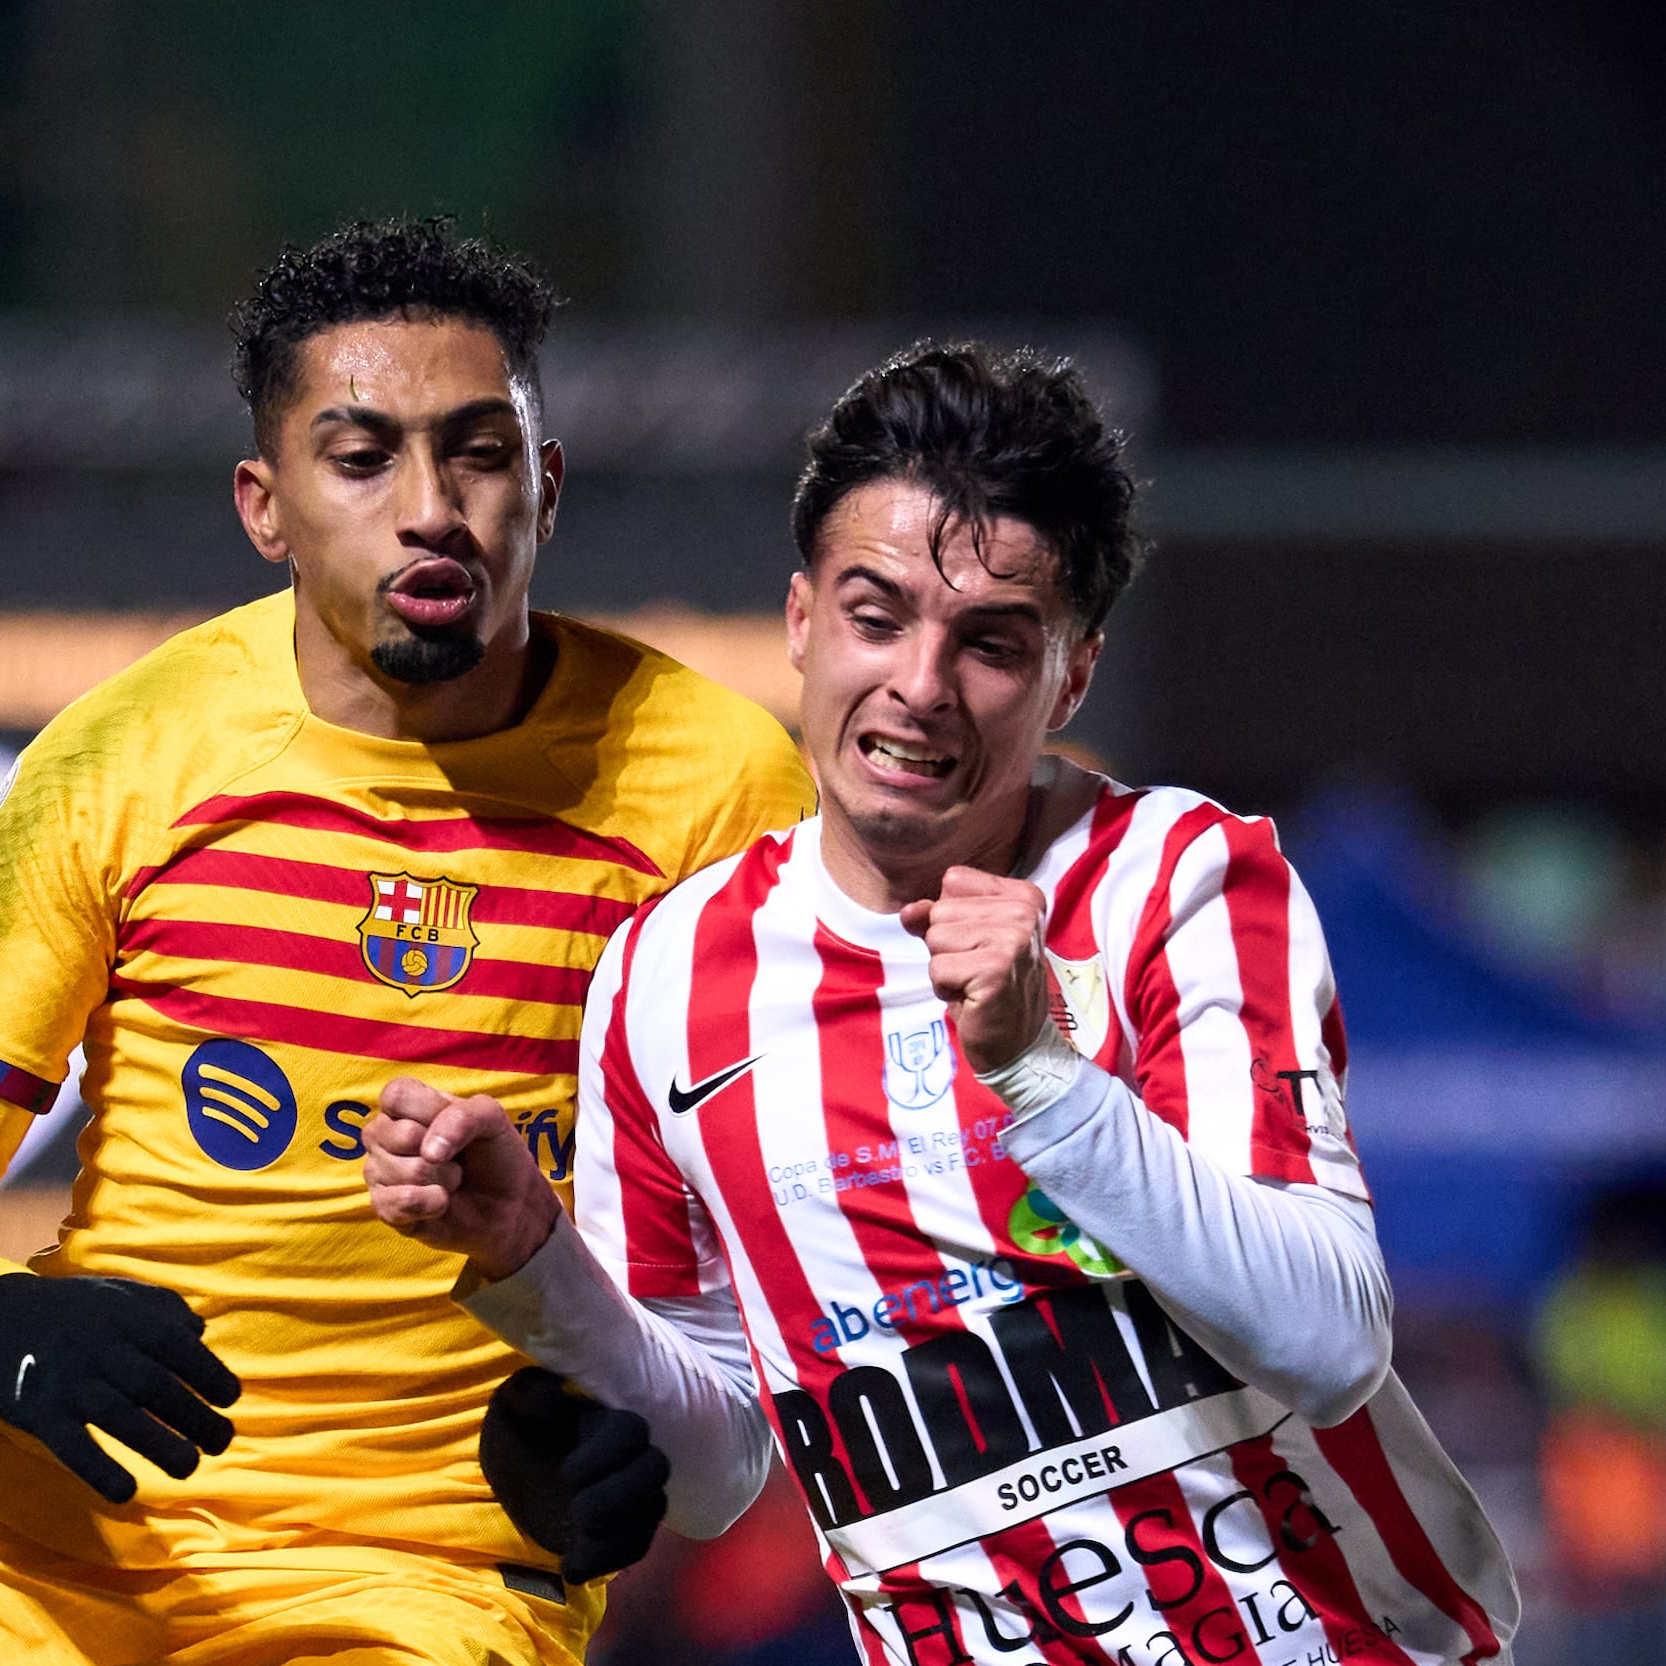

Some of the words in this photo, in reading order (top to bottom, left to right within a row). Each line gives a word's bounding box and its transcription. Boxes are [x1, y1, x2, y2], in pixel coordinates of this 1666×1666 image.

[396, 924, 439, 942] FCB
[318, 1100, 574, 1181] Sify
[768, 1158, 818, 1184] Copa
[825, 1151, 850, 1171] de
[908, 1136, 927, 1154] El
[933, 1128, 969, 1150] Rey
[773, 1183, 813, 1207] U.D.
[818, 1164, 918, 1194] Barbastro
[923, 1160, 944, 1177] vs
[997, 1445, 1129, 1512] SOCCER
